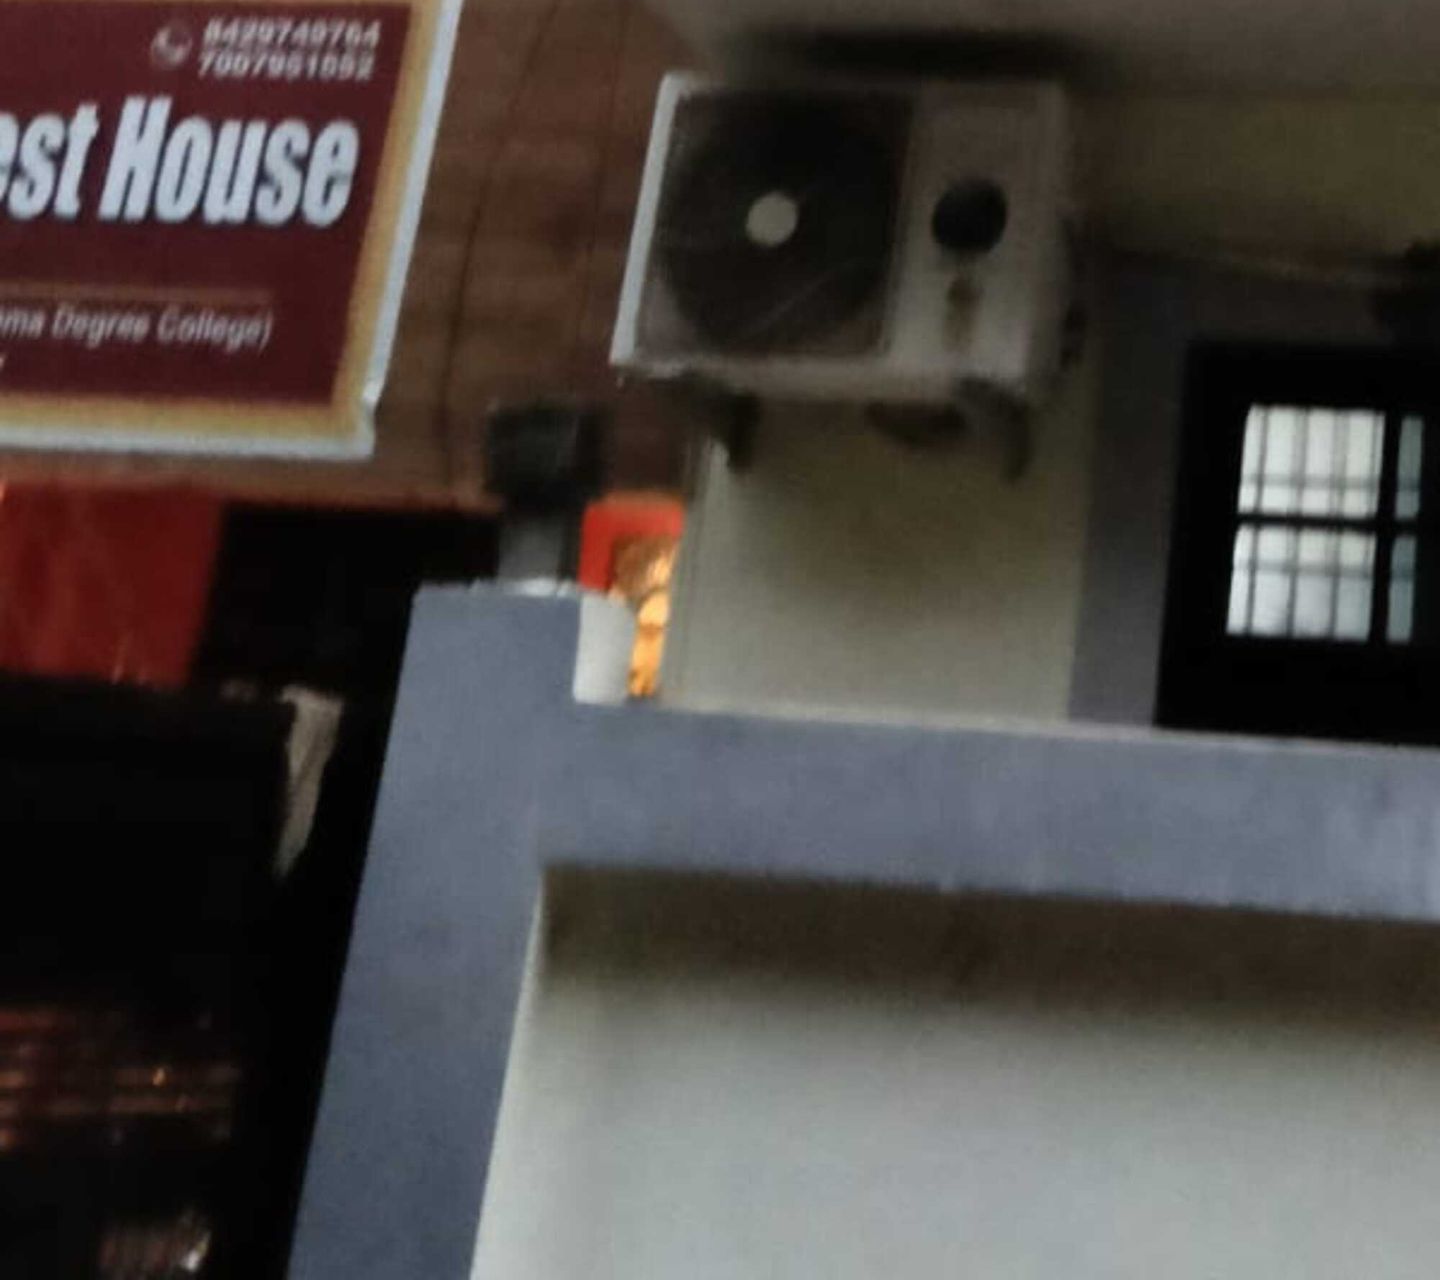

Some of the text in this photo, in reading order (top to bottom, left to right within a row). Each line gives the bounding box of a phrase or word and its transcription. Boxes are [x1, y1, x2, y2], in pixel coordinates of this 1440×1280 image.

[97, 93, 360, 228] House
[50, 303, 149, 349] Degree
[157, 303, 274, 355] College)
